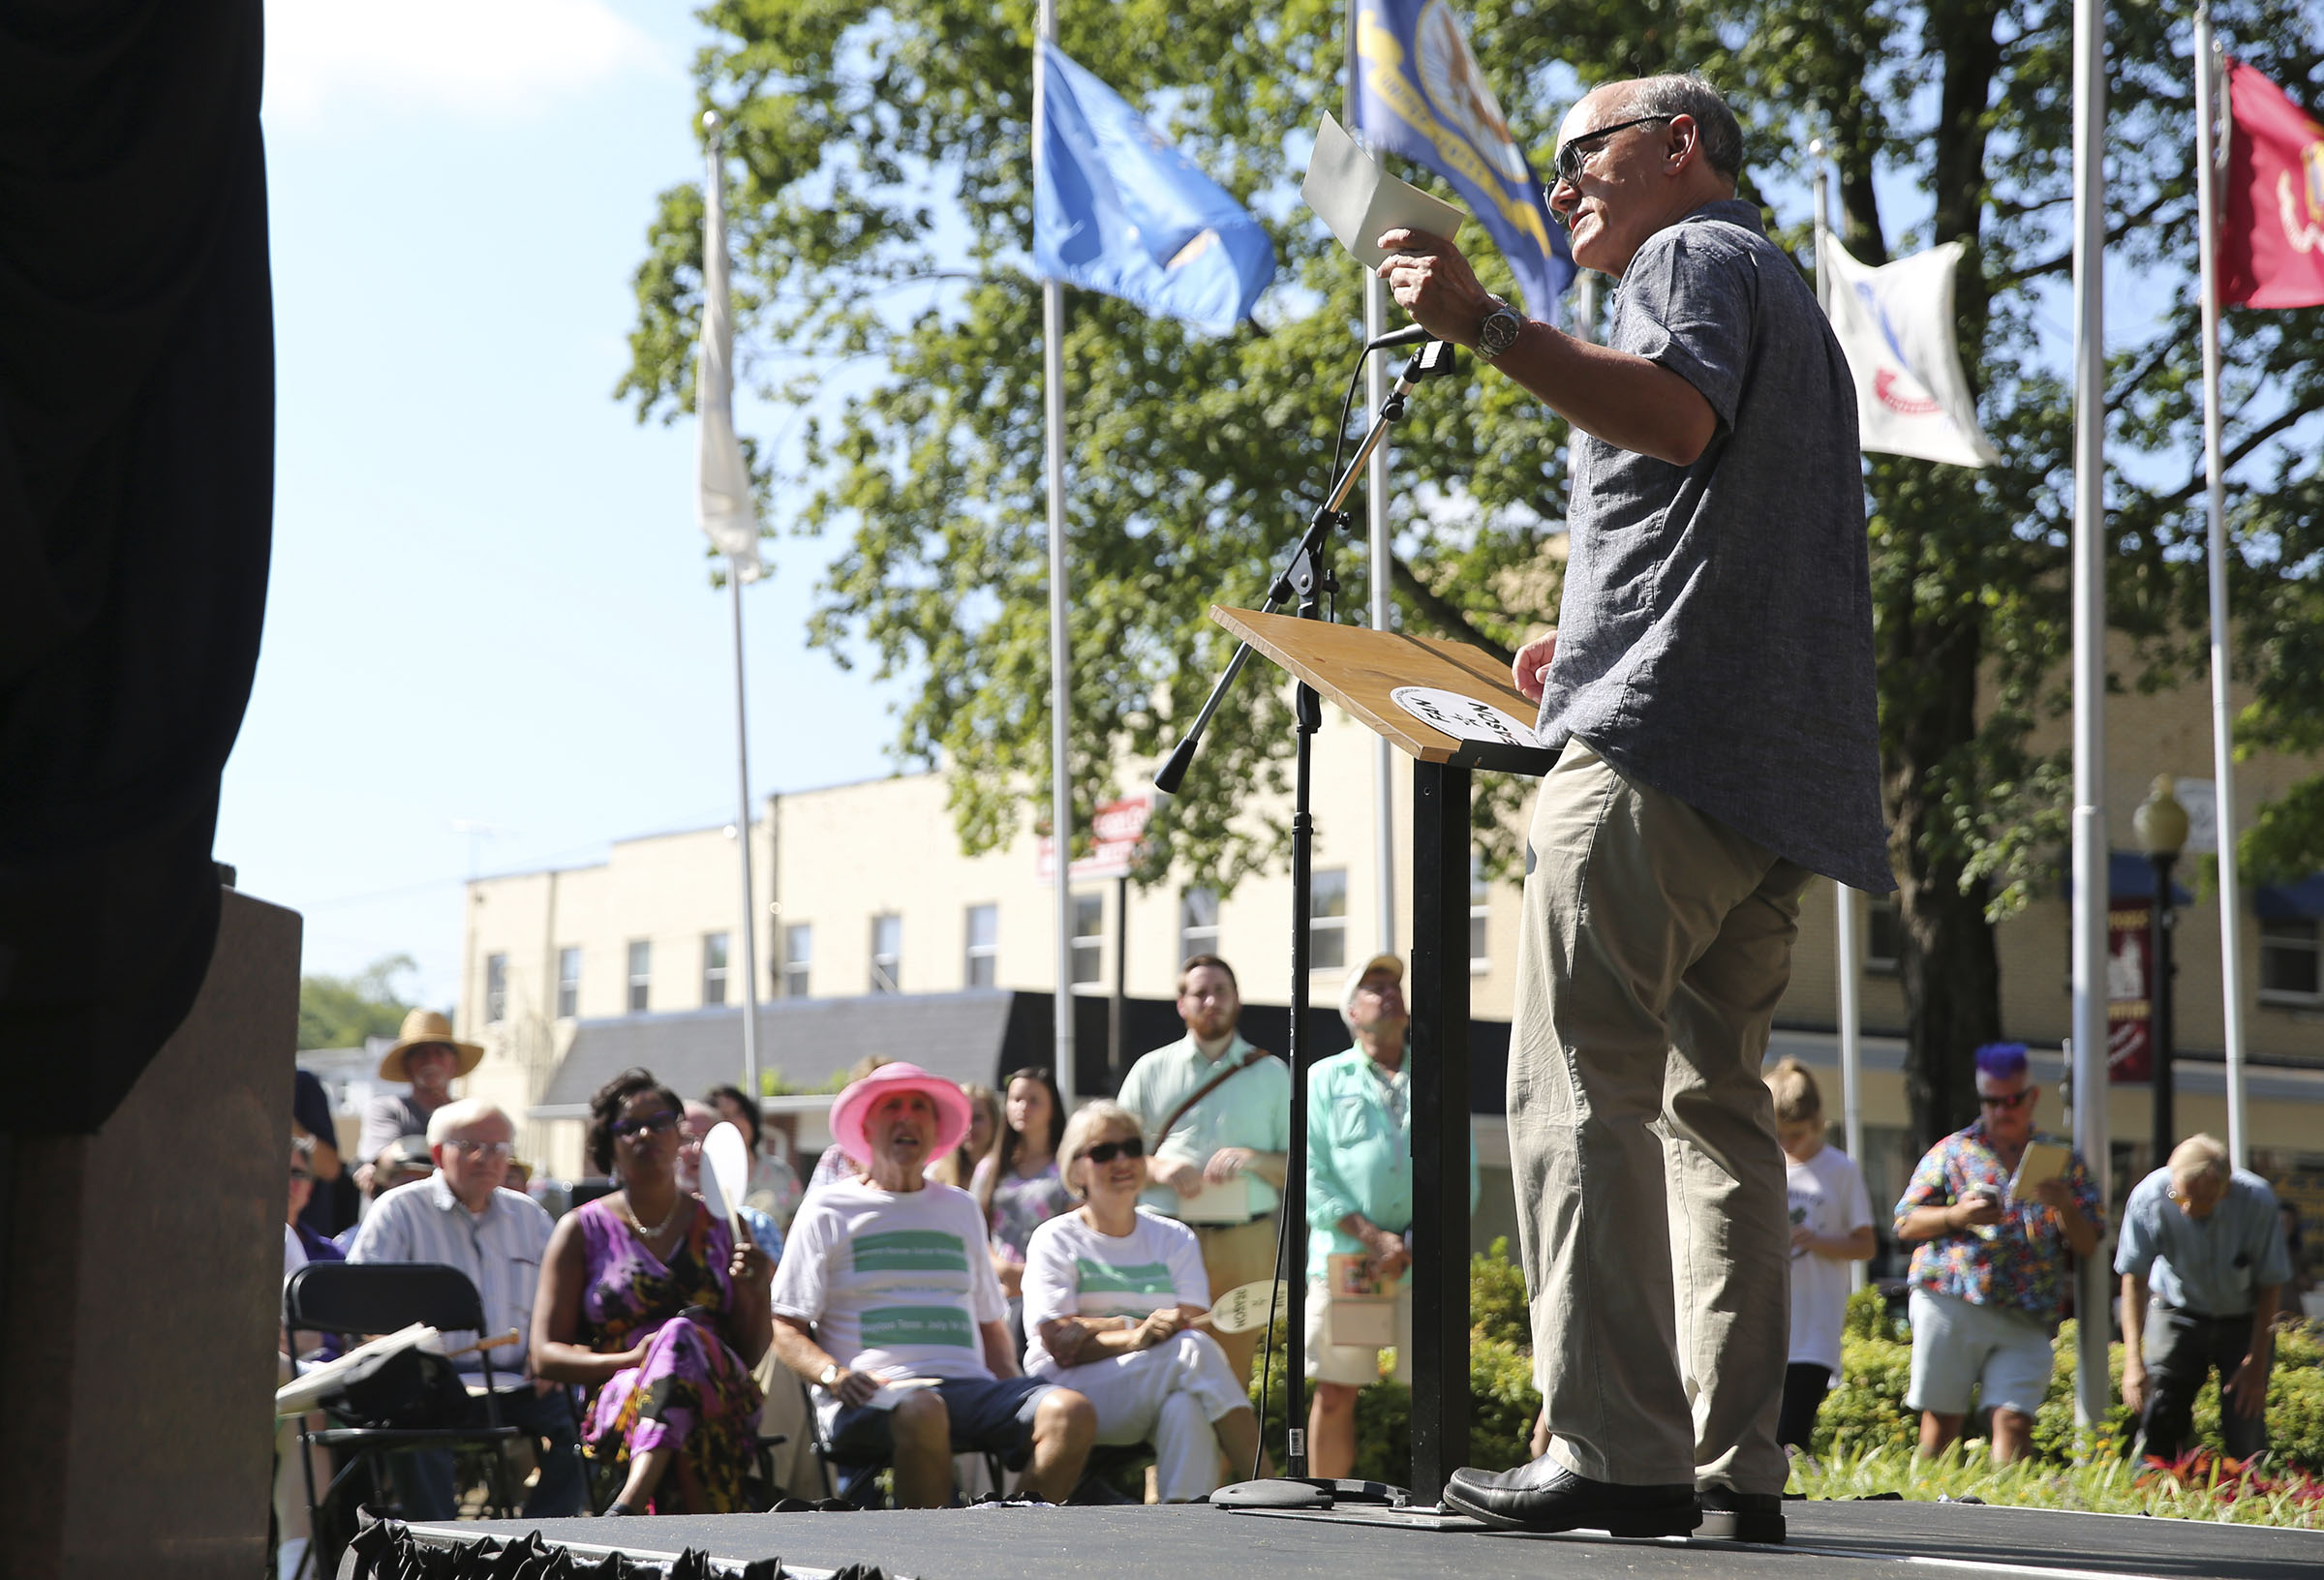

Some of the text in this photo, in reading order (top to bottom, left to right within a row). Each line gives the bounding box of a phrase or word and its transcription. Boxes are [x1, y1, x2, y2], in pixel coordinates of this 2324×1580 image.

[1410, 696, 1452, 724] FAN
[1467, 701, 1523, 747] EASON
[1233, 1288, 1247, 1327] REASON
